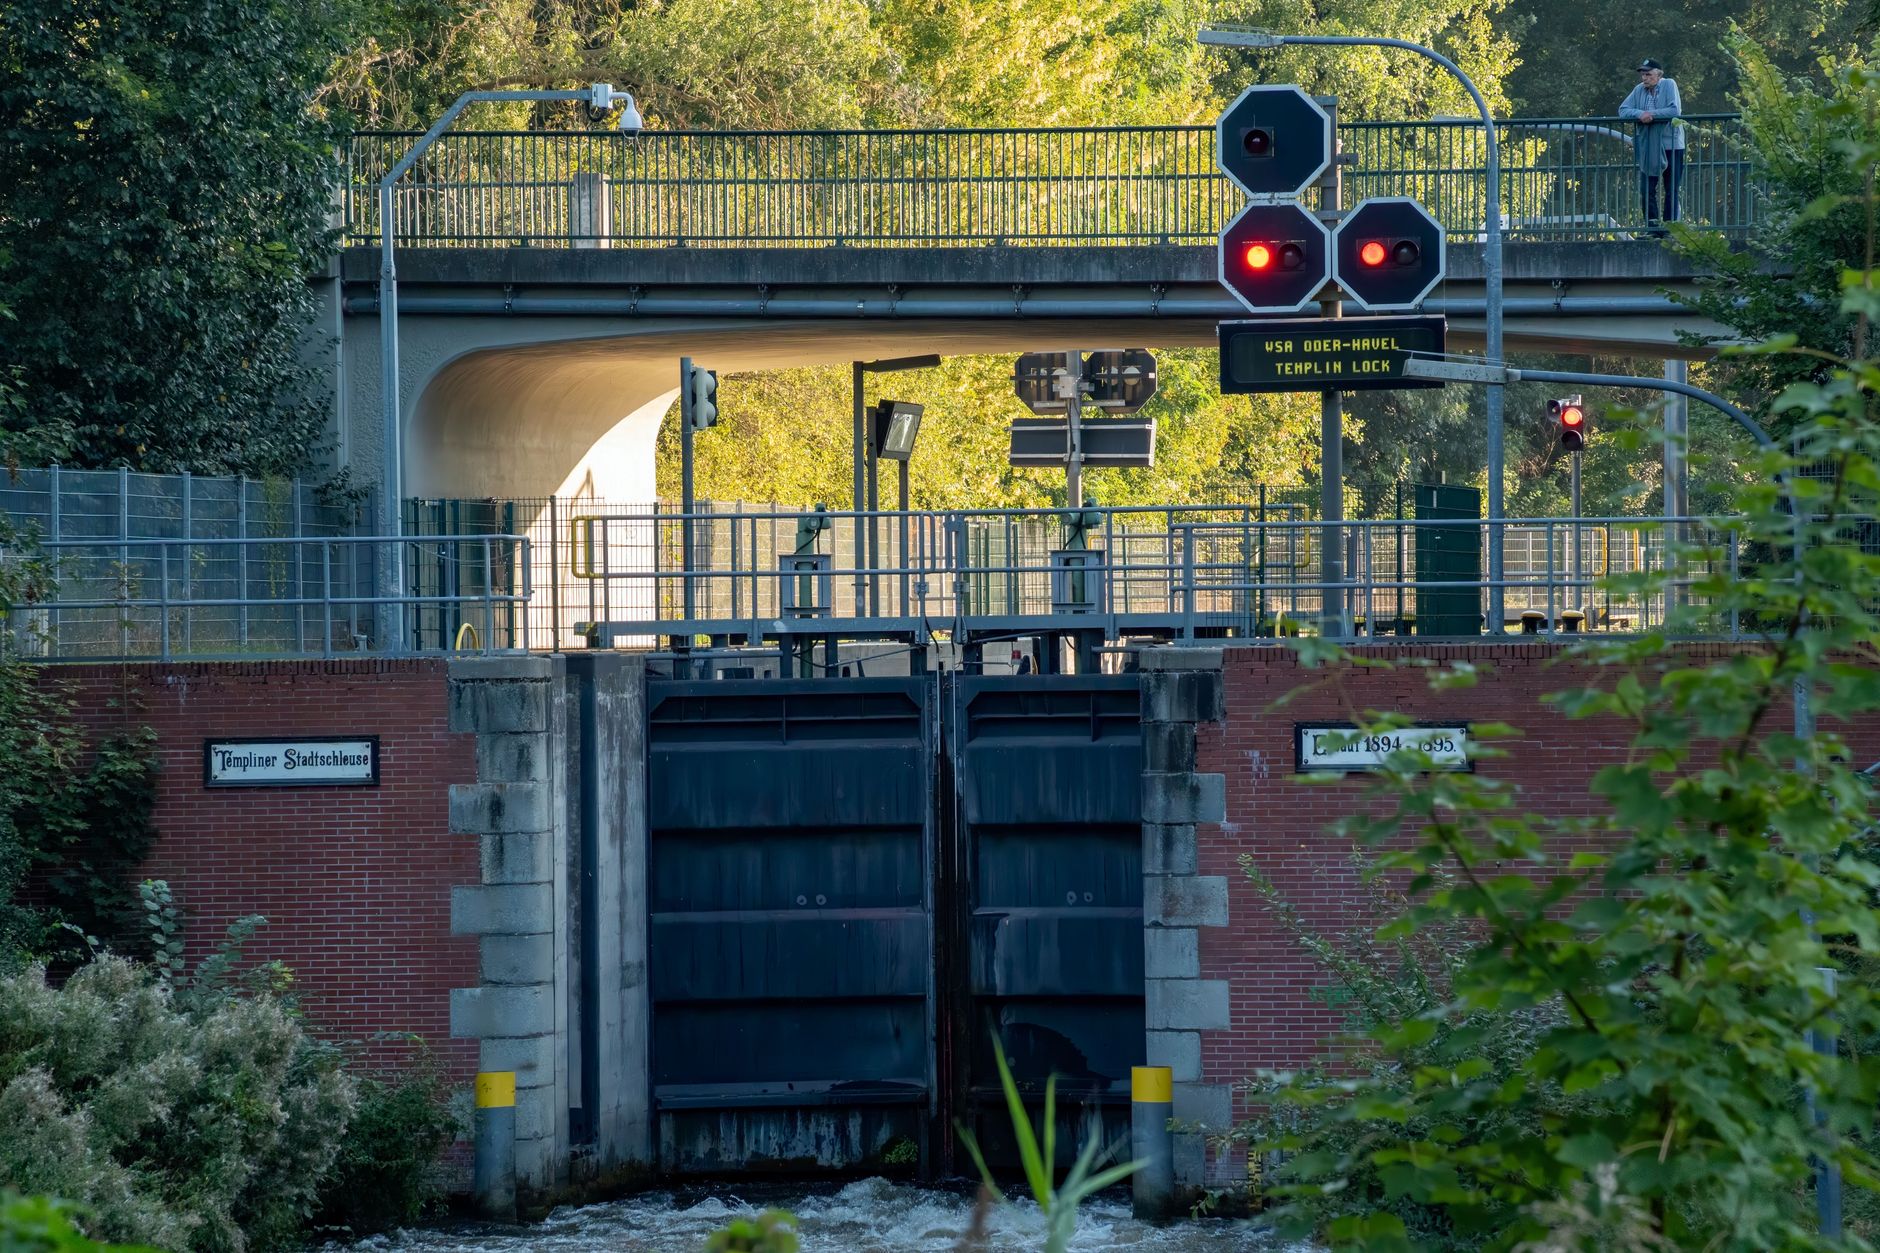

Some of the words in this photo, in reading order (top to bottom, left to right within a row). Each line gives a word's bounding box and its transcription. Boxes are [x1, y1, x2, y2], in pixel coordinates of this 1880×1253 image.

[1265, 340, 1293, 353] WSA
[1304, 337, 1399, 353] ODER-HAVEL
[1275, 360, 1342, 375] TEMPLIN
[1353, 360, 1390, 374] LOCK
[1363, 735, 1402, 753] 1894
[214, 749, 278, 772] Templiner
[283, 748, 369, 770] Stadtschleuse
